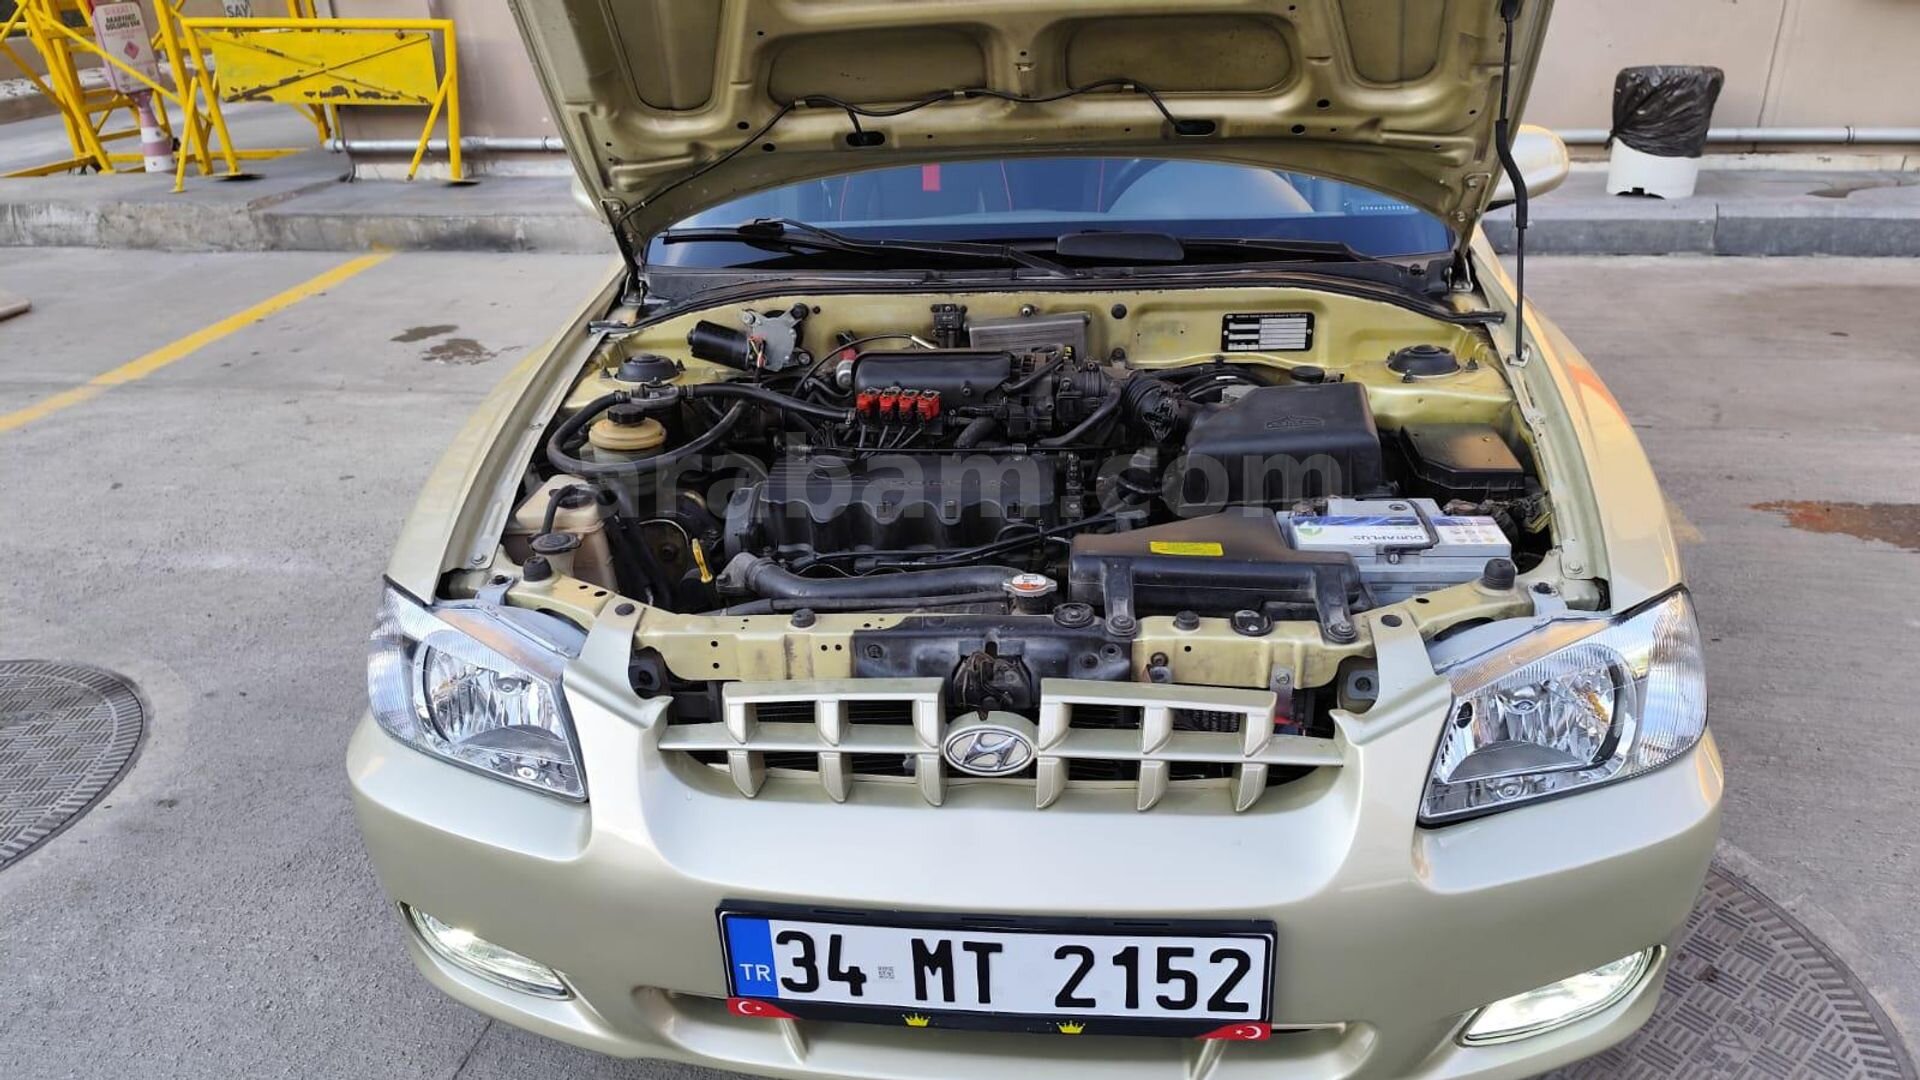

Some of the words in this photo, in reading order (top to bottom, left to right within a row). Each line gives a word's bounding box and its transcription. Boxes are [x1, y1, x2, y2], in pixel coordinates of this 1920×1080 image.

[739, 963, 771, 982] TR
[775, 930, 868, 997] 34
[910, 937, 1004, 1004] MT
[1053, 944, 1252, 1013] 2152
